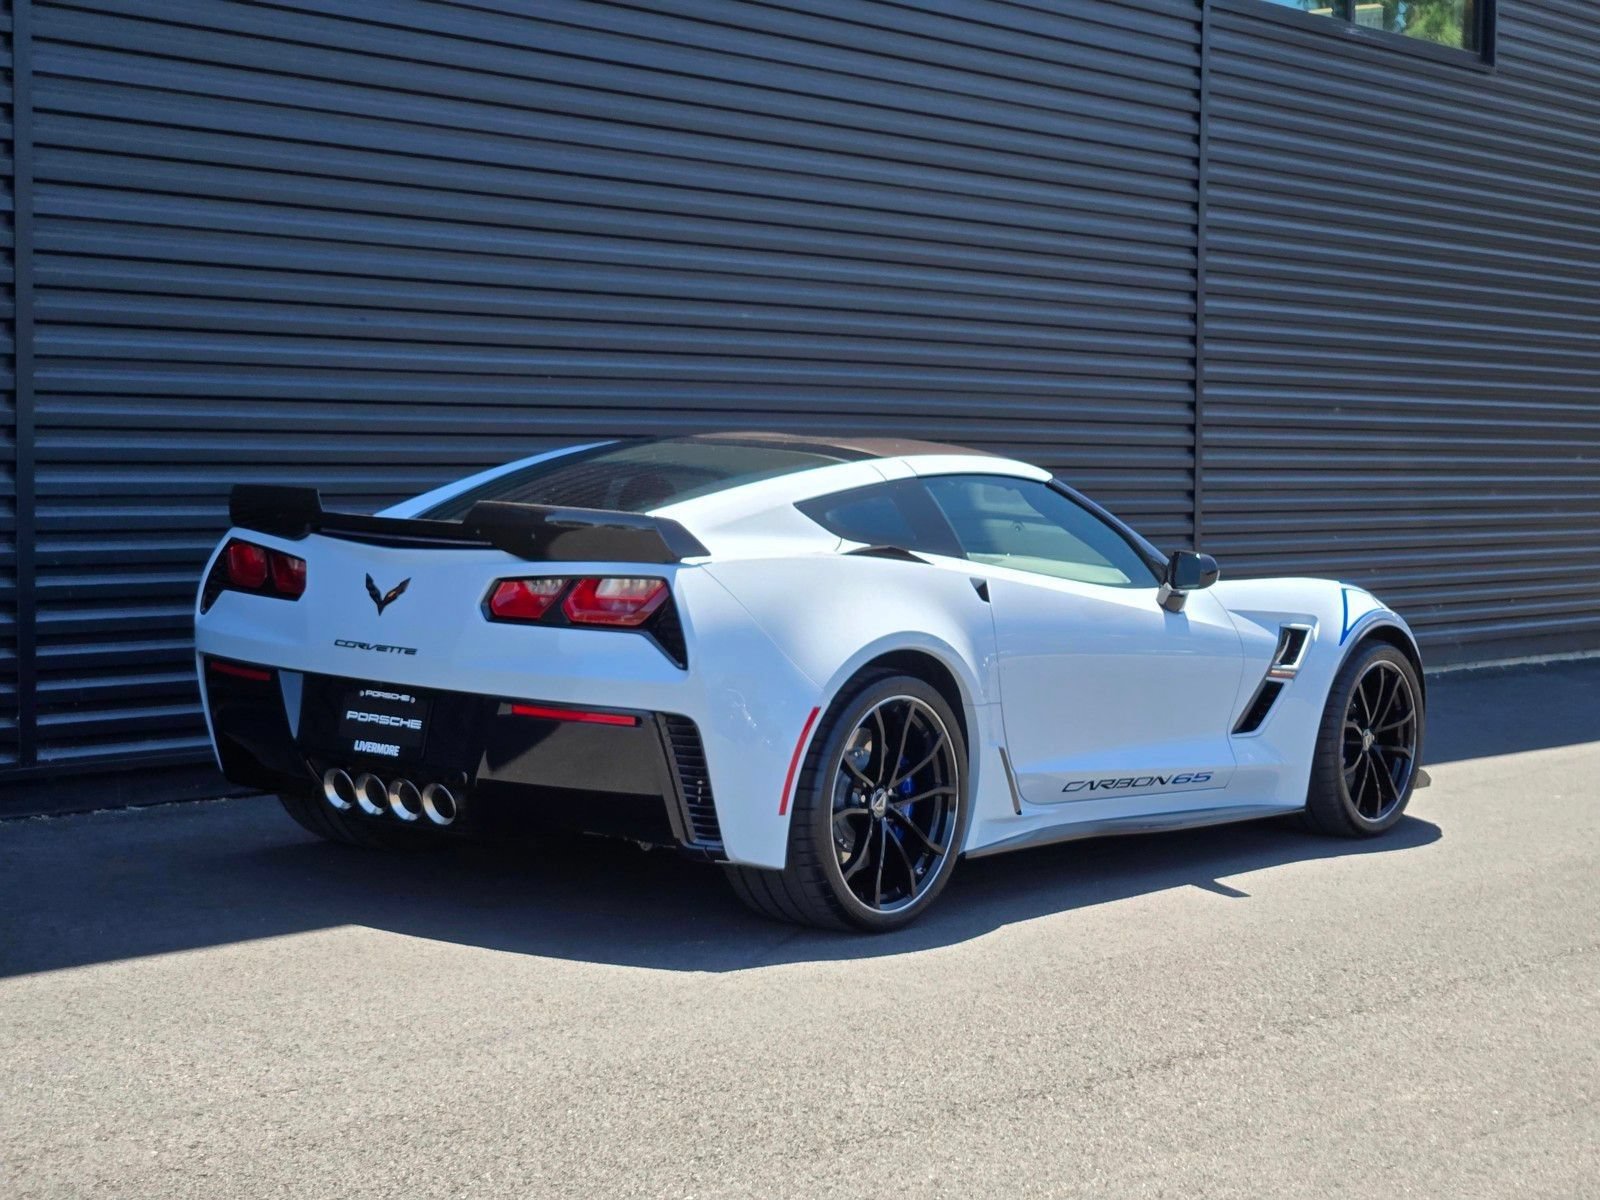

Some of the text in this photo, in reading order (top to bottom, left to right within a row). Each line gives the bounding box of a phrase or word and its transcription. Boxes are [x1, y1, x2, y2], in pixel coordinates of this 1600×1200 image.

[334, 639, 418, 655] CORVETTE
[365, 689, 411, 702] PORSCHE
[346, 710, 422, 730] PORSCHE
[353, 739, 400, 757] LIVERMORE
